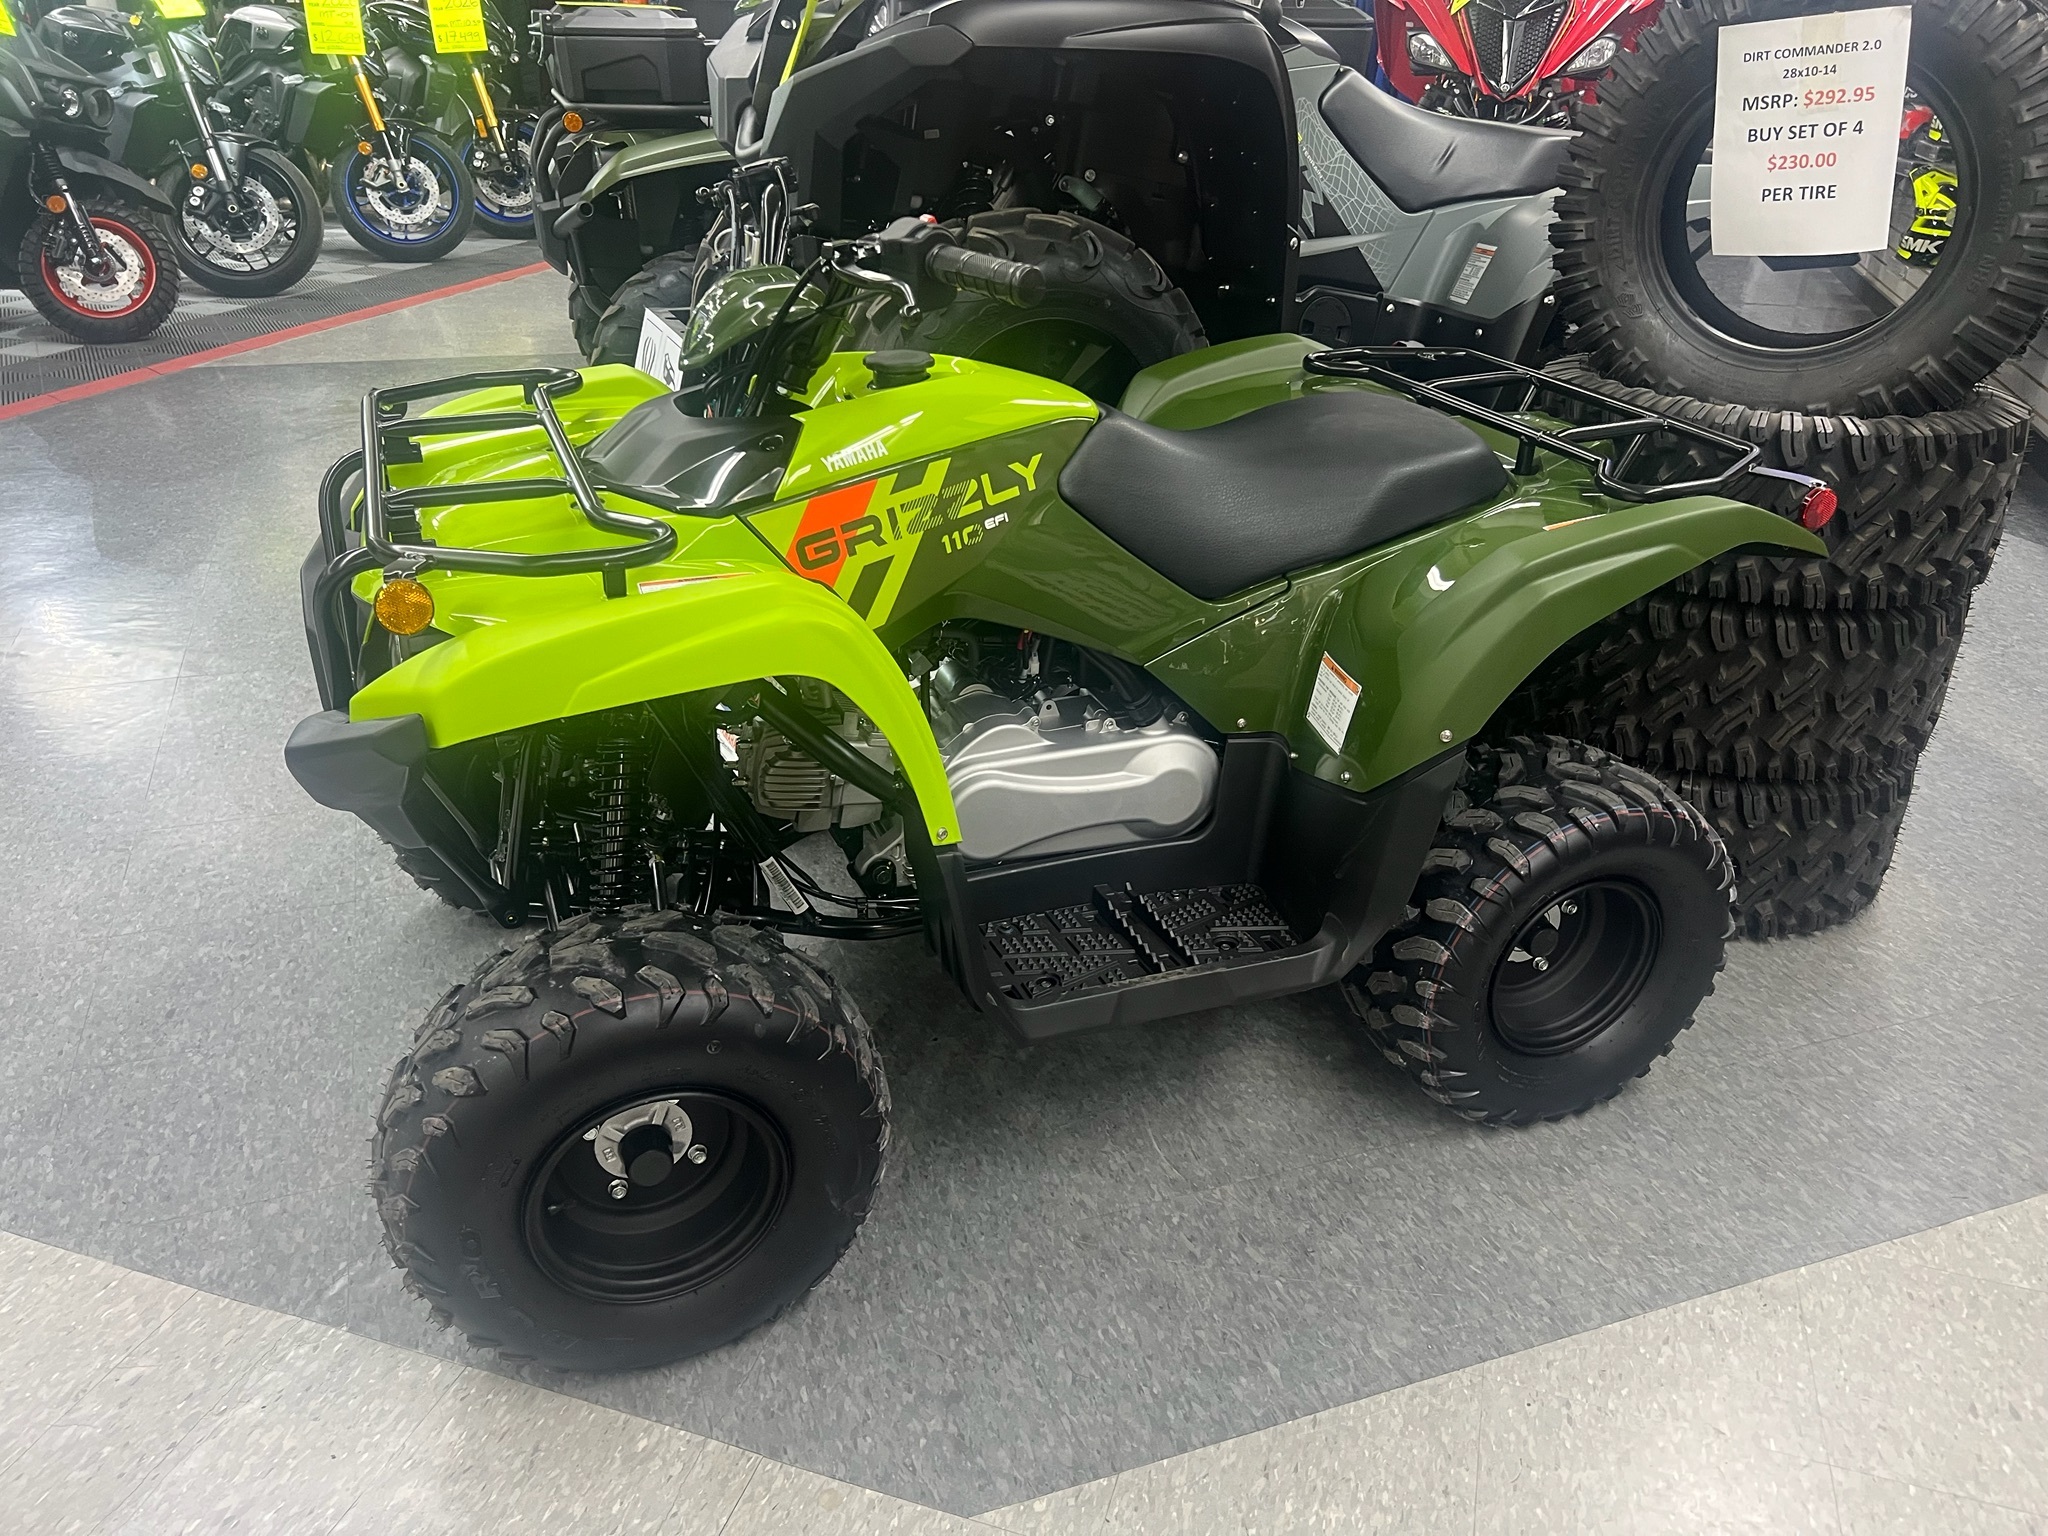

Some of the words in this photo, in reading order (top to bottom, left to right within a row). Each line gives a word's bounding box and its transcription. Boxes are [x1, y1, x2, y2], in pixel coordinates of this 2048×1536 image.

[1743, 50, 1771, 62] DIRT
[1774, 41, 1859, 59] COMMANDER
[1862, 39, 1882, 51] 2.0
[1783, 64, 1837, 79] 28x10-14
[1742, 93, 1798, 111] MSRP:
[1803, 86, 1875, 109] $292.95
[1747, 126, 1783, 142] BUY
[1787, 123, 1819, 140] SET
[1823, 121, 1848, 137] OF
[1852, 120, 1864, 135] 4
[1767, 152, 1837, 173] $230.00
[1762, 187, 1793, 202] PER
[1799, 184, 1837, 200] TIRE
[1900, 235, 1944, 254] SMK
[820, 439, 889, 473] YAMAHA
[795, 452, 1043, 570] GRIZZLY
[941, 522, 984, 554] 110
[984, 512, 1009, 530] EFI
